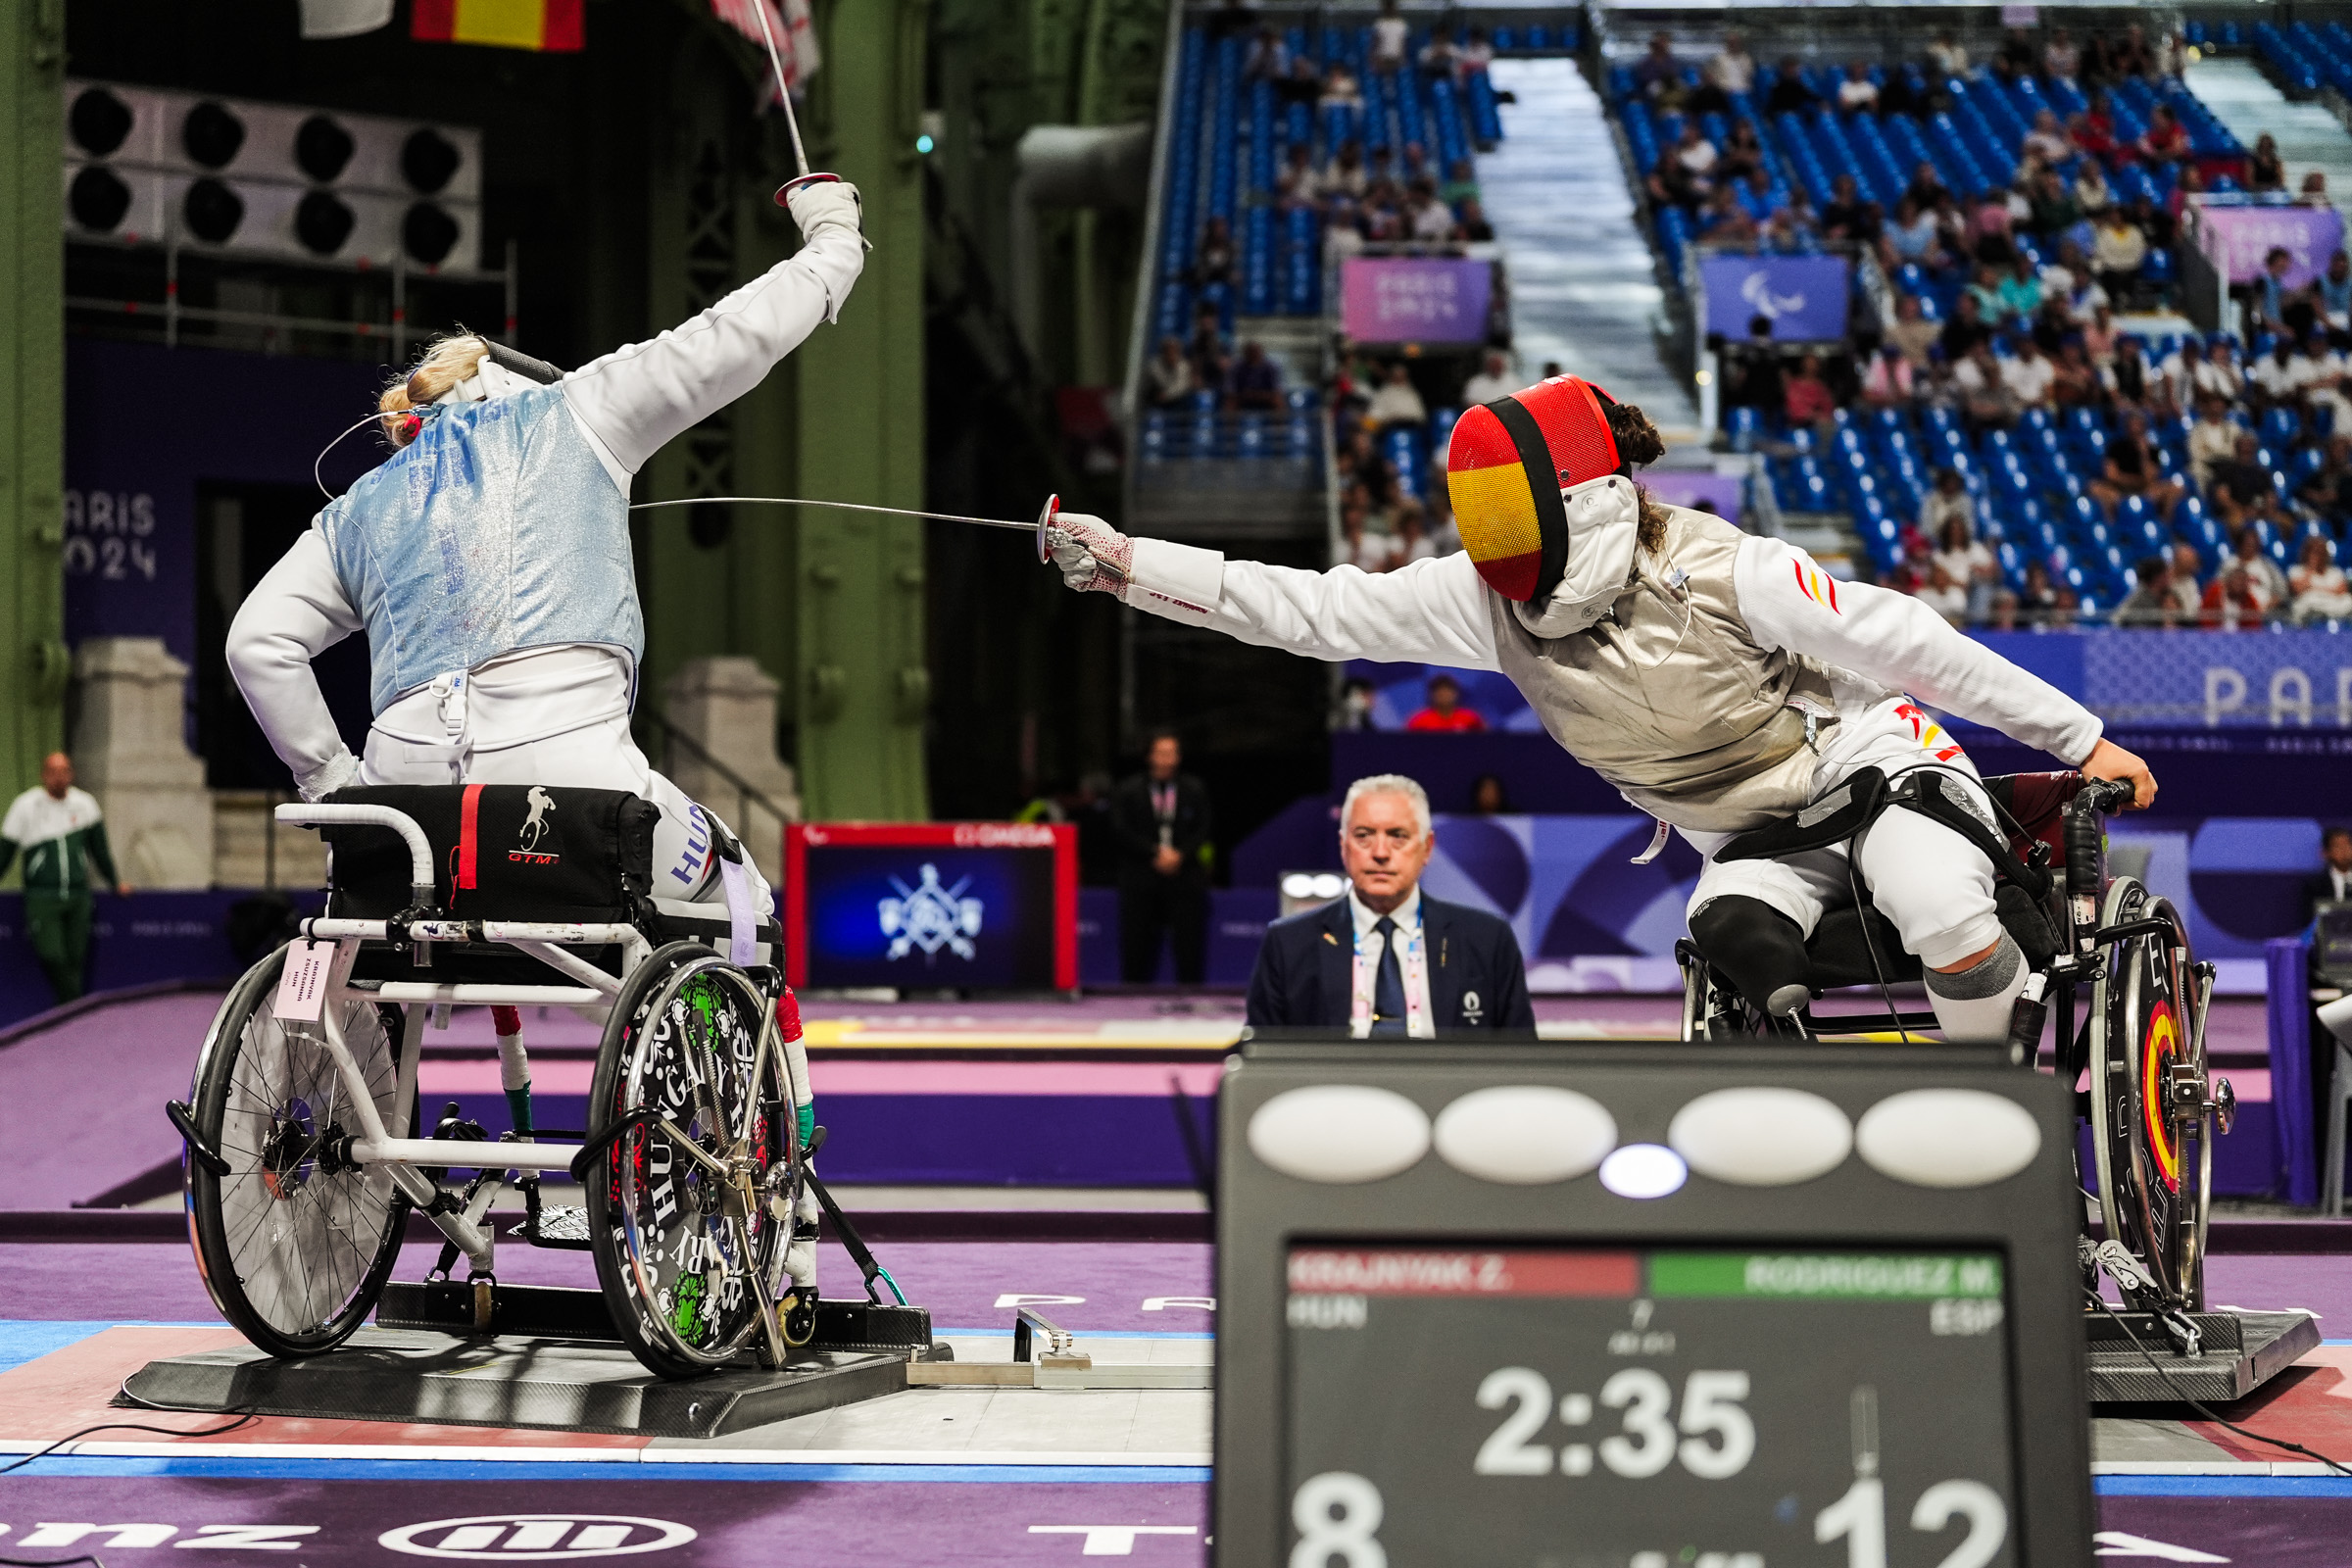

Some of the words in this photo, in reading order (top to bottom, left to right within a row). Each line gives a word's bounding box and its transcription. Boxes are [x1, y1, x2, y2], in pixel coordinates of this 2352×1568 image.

[63, 490, 155, 536] ARIS
[62, 536, 156, 580] 024
[2206, 666, 2352, 727] PA
[650, 1051, 729, 1227] HUNGAY
[1744, 1254, 1955, 1295] RODRIGUEZ
[1286, 1295, 1367, 1328] HUN
[1930, 1298, 2003, 1335] ESP
[1474, 1367, 1758, 1478] 2:35
[0, 1522, 321, 1550] nz
[1288, 1471, 1389, 1568] 8
[1815, 1478, 2009, 1568] 12
